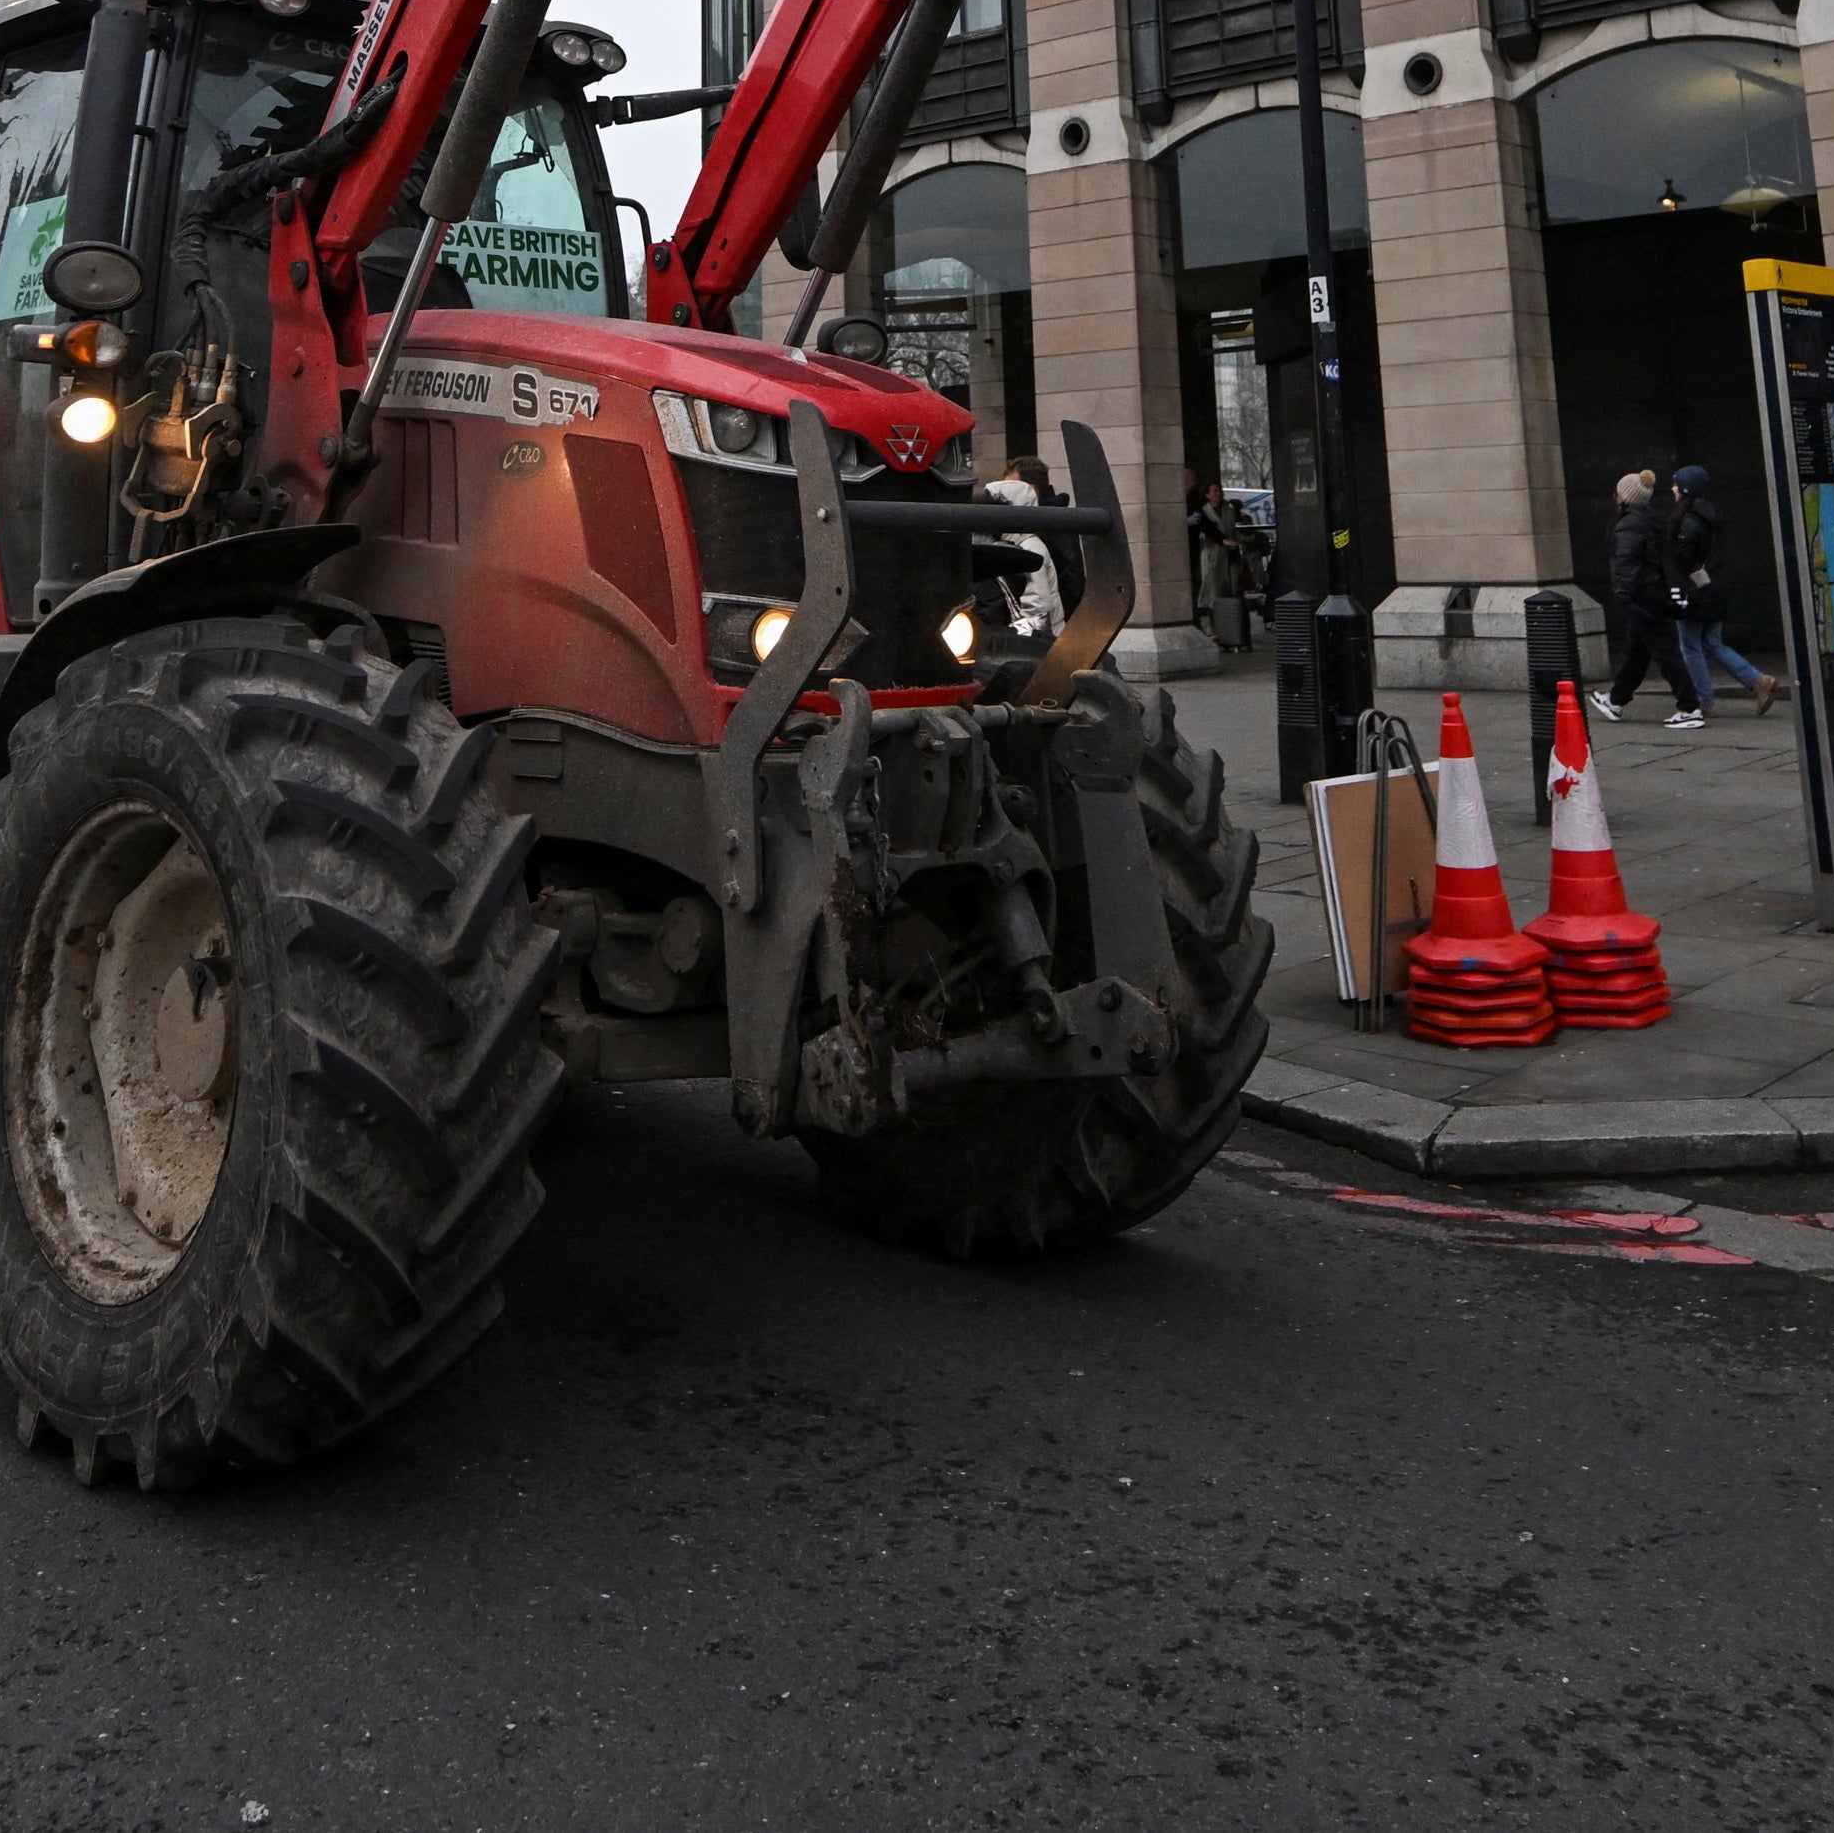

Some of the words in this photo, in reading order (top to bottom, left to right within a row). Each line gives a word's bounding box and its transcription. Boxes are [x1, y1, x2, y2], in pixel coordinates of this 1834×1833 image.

[443, 224, 505, 250] SAVE
[509, 228, 597, 257] BRITISH
[441, 251, 599, 292] FARMING
[1311, 281, 1322, 295] A
[1312, 297, 1324, 313] 3
[404, 370, 491, 403] FERGUSON
[512, 372, 538, 418] S
[519, 447, 540, 463] C&O
